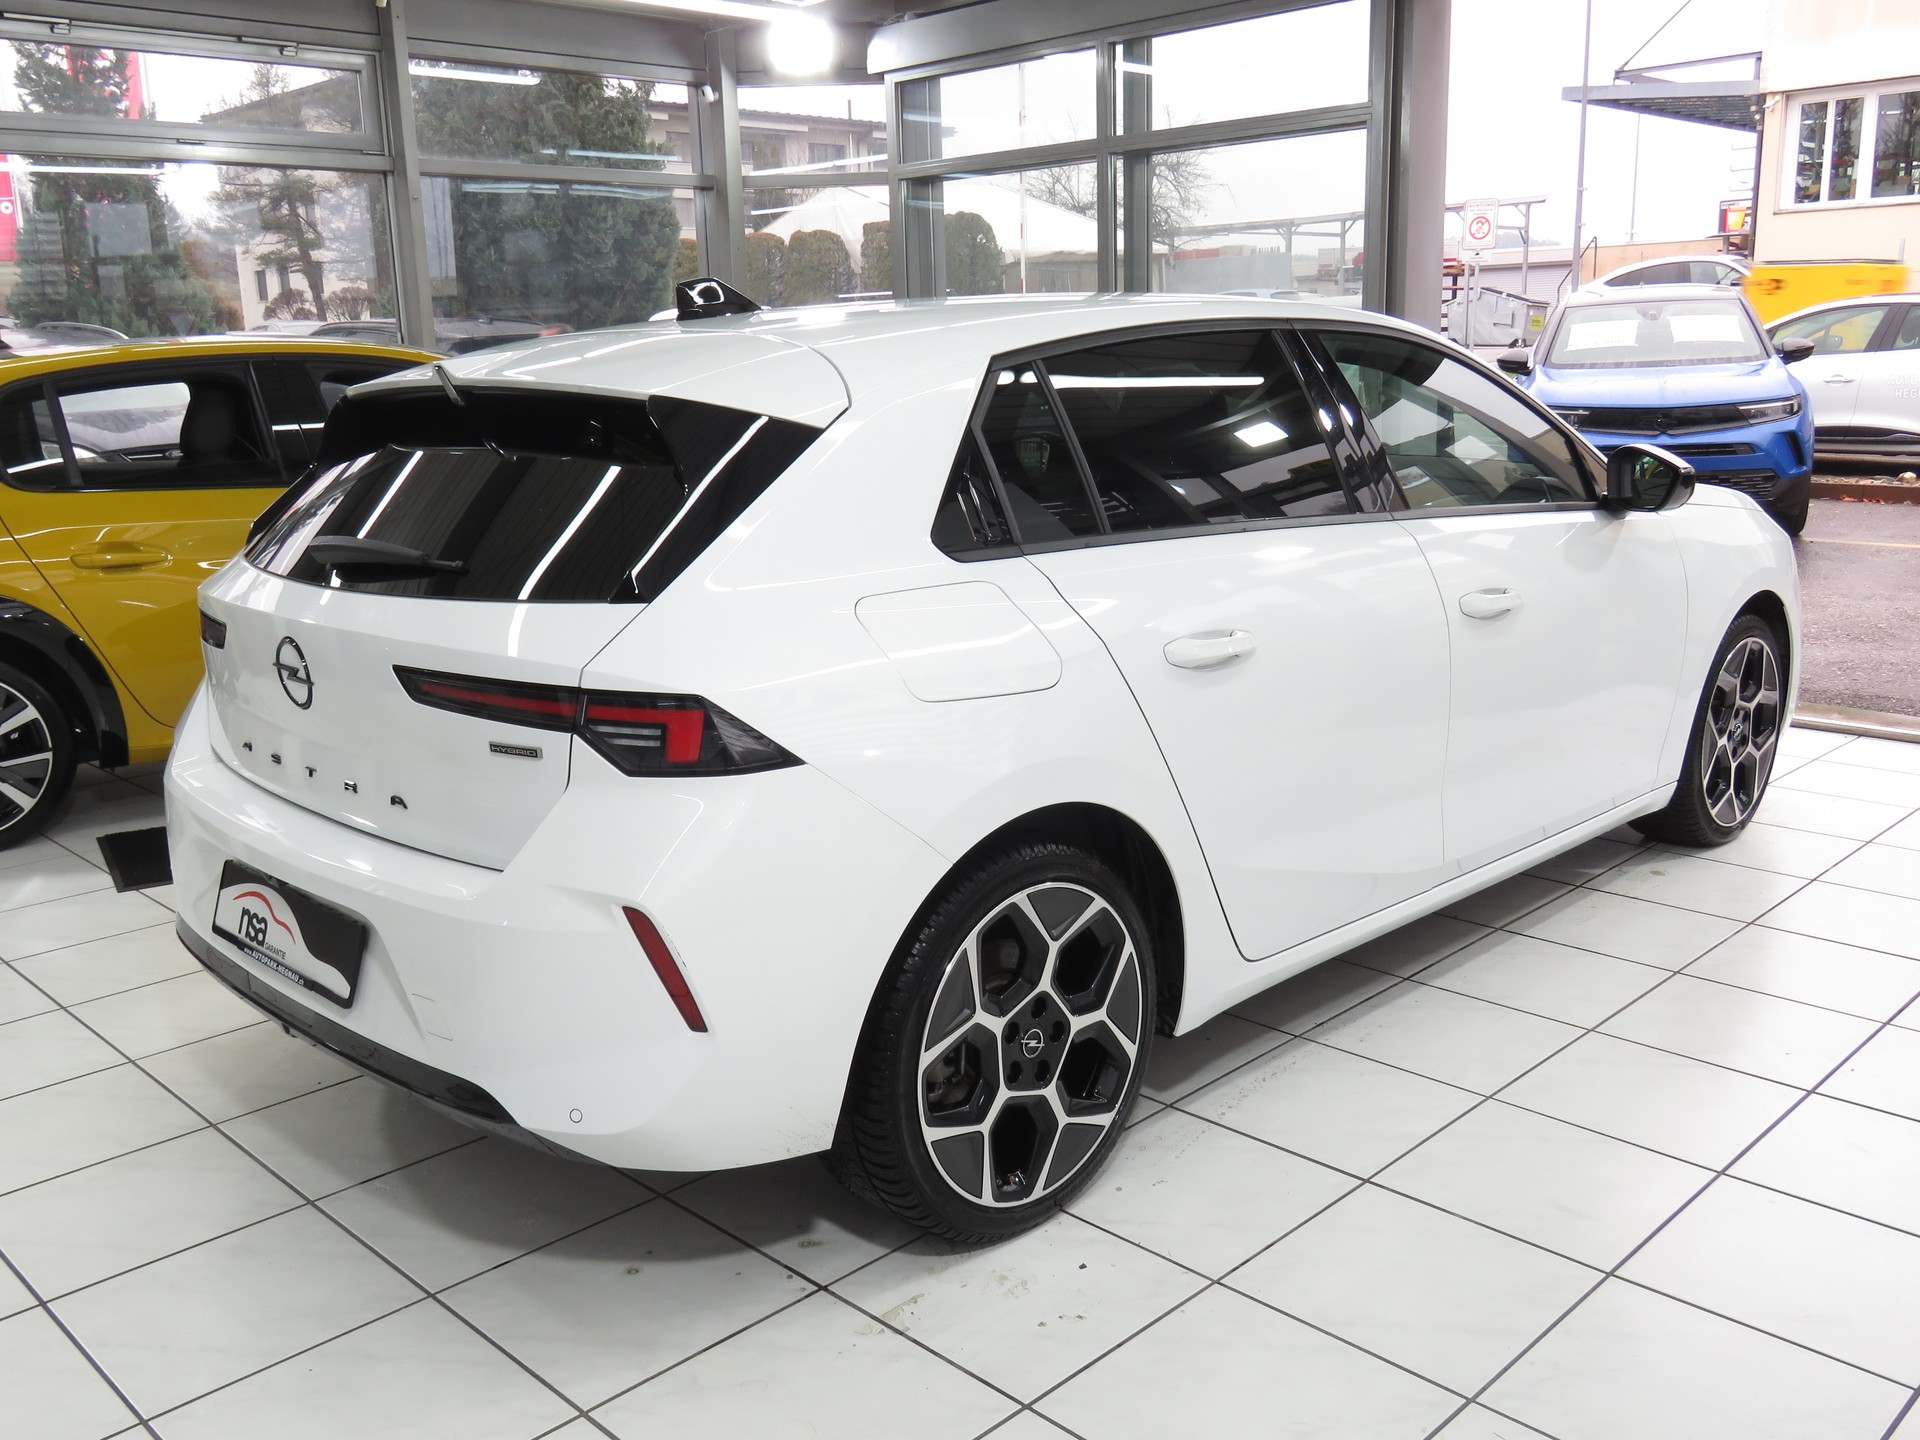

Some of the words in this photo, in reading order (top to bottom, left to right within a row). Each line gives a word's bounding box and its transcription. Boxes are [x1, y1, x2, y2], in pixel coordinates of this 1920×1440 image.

[1887, 375, 1920, 385] AUTO
[1894, 388, 1920, 399] HEG
[491, 745, 536, 757] HYBRID
[242, 740, 408, 810] ASTRA
[238, 906, 268, 948] nsa
[265, 942, 286, 960] GARANTIE
